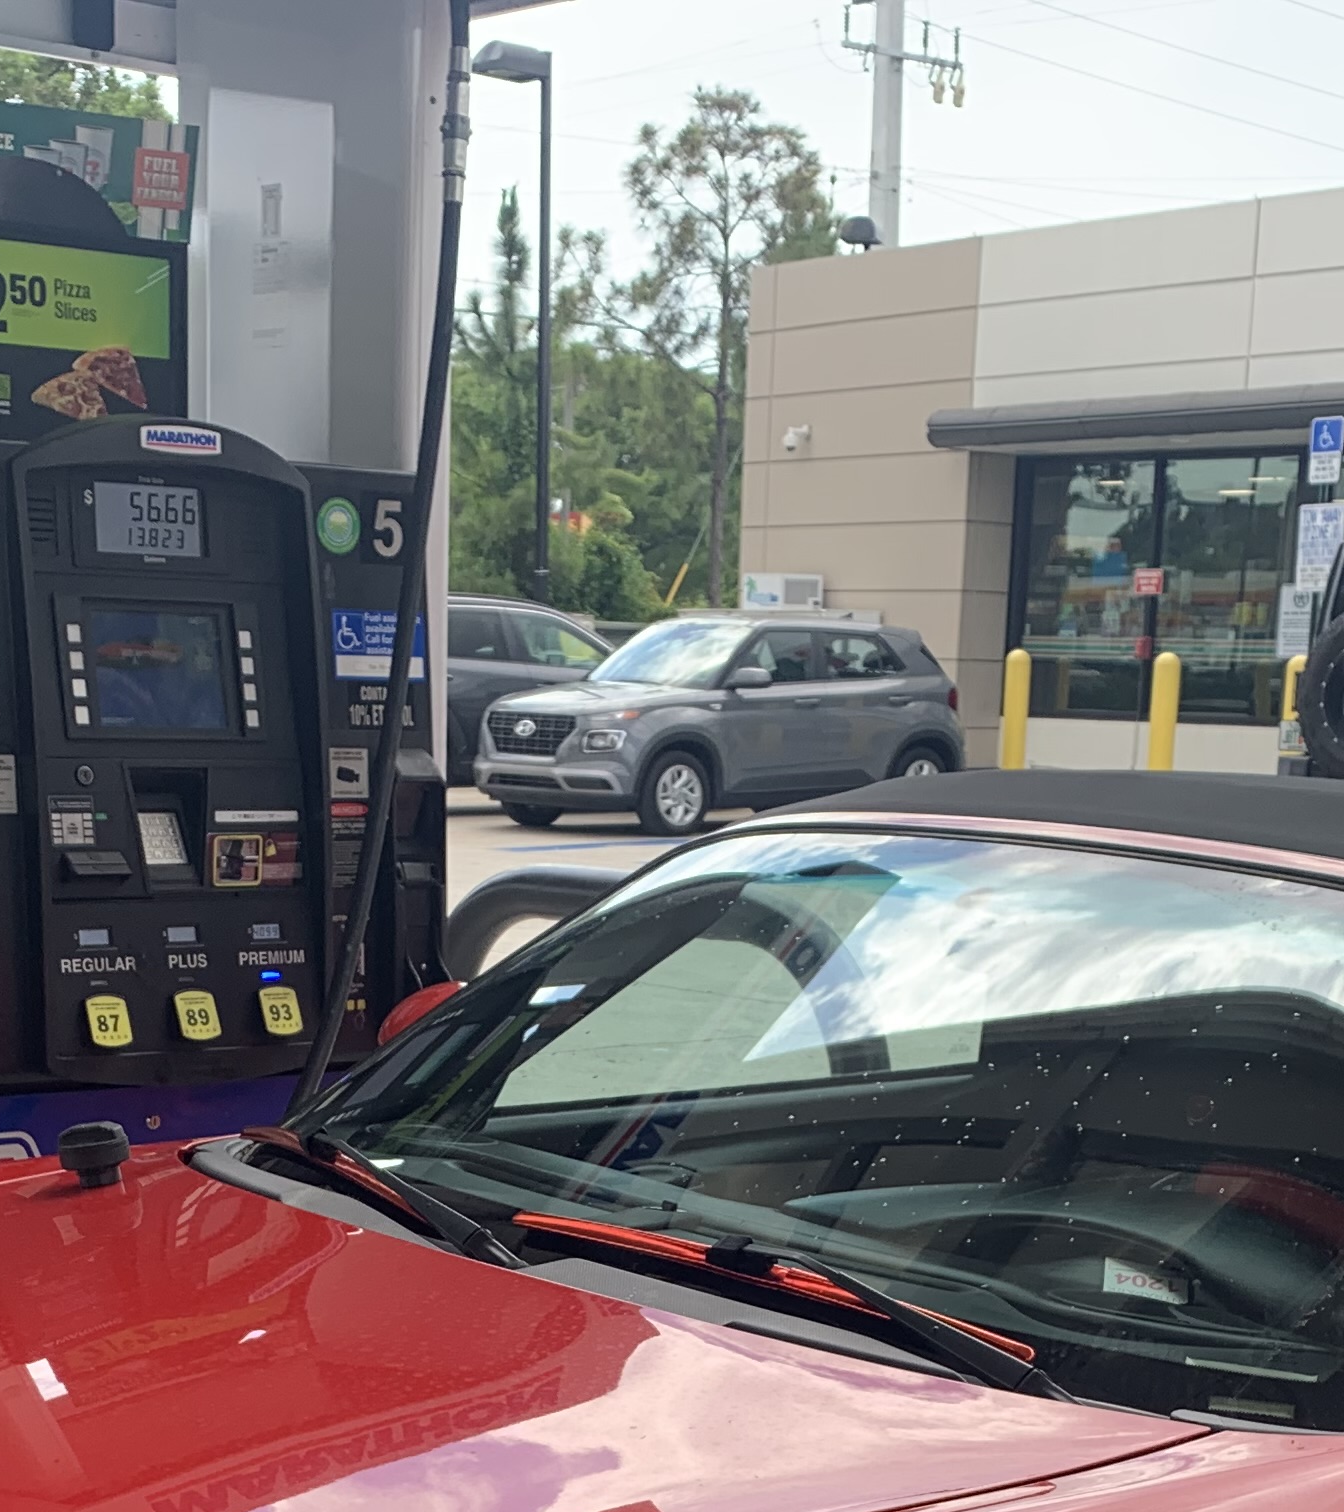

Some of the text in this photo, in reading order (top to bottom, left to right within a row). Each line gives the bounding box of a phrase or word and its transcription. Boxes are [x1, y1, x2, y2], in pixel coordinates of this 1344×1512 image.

[54, 277, 91, 300] Pizza
[54, 300, 97, 323] Slices
[146, 429, 217, 446] MARATHON
[83, 488, 93, 506] $
[373, 499, 404, 558] 5
[349, 704, 371, 726] 10%
[60, 955, 137, 974] REGULAR
[168, 953, 208, 969] PLUS
[239, 949, 305, 966] PREMIUM
[185, 1008, 210, 1026] 89
[268, 1003, 293, 1022] 93
[96, 1014, 120, 1033] 87
